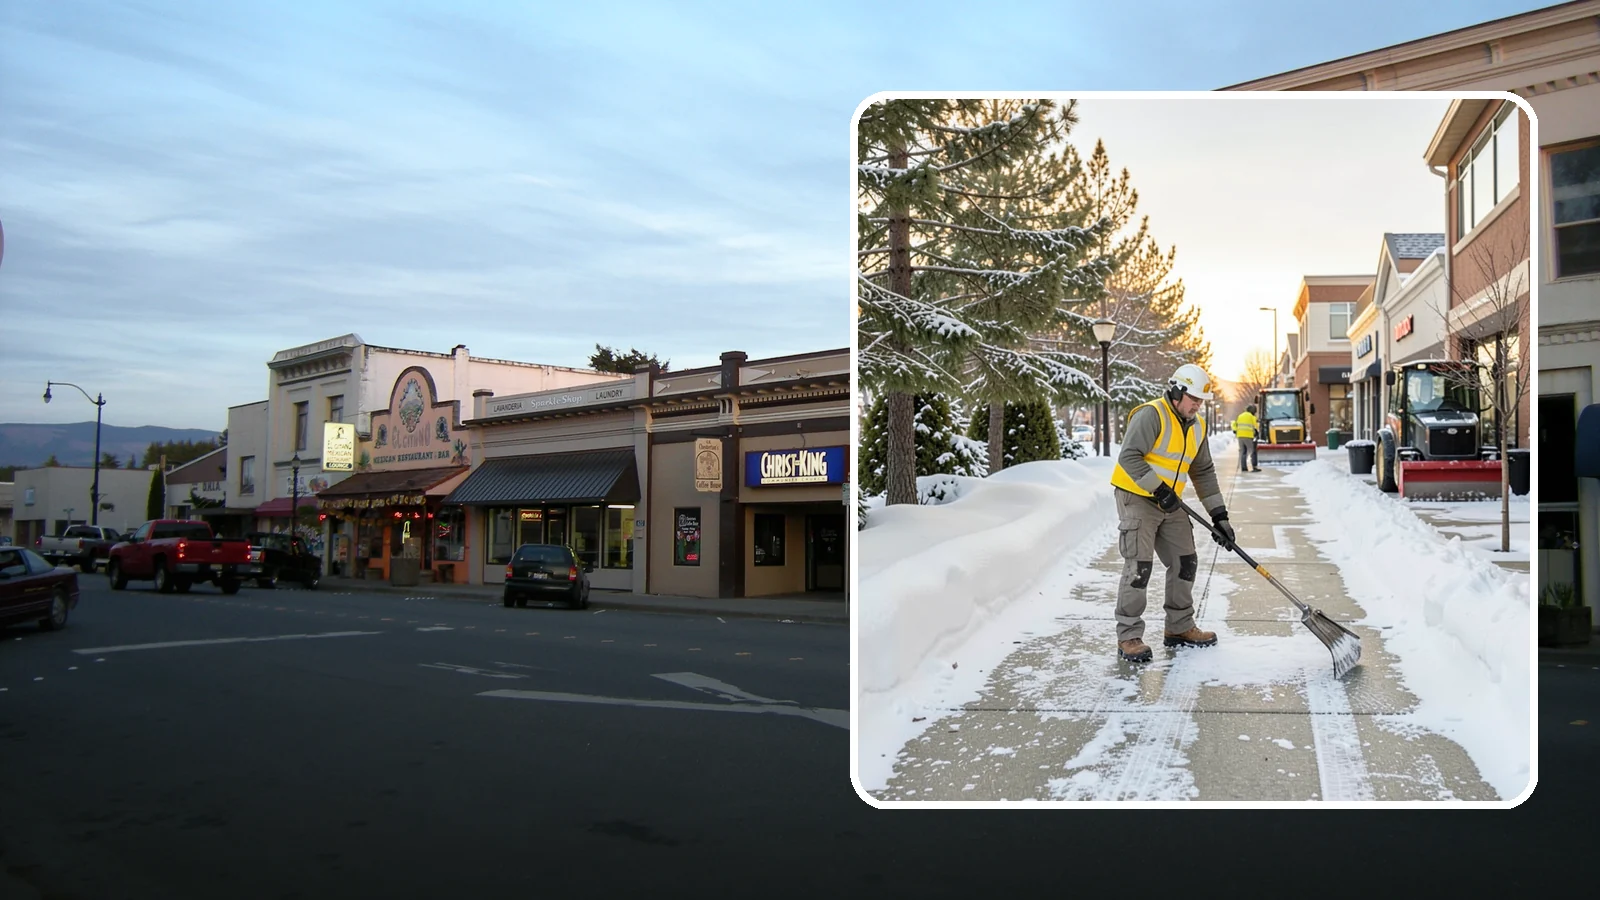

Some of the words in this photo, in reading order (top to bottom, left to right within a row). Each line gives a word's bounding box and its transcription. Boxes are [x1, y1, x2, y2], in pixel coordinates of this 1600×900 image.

[531, 397, 562, 408] Sparkle
[562, 394, 582, 404] Shop
[595, 389, 623, 400] LAUNDRY
[493, 402, 522, 412] LAVANDERIA
[374, 455, 396, 464] MEXICAN
[397, 452, 433, 462] RESTAURANT
[438, 450, 450, 459] BAR
[761, 452, 797, 478] CHRIST
[799, 450, 827, 476] KING
